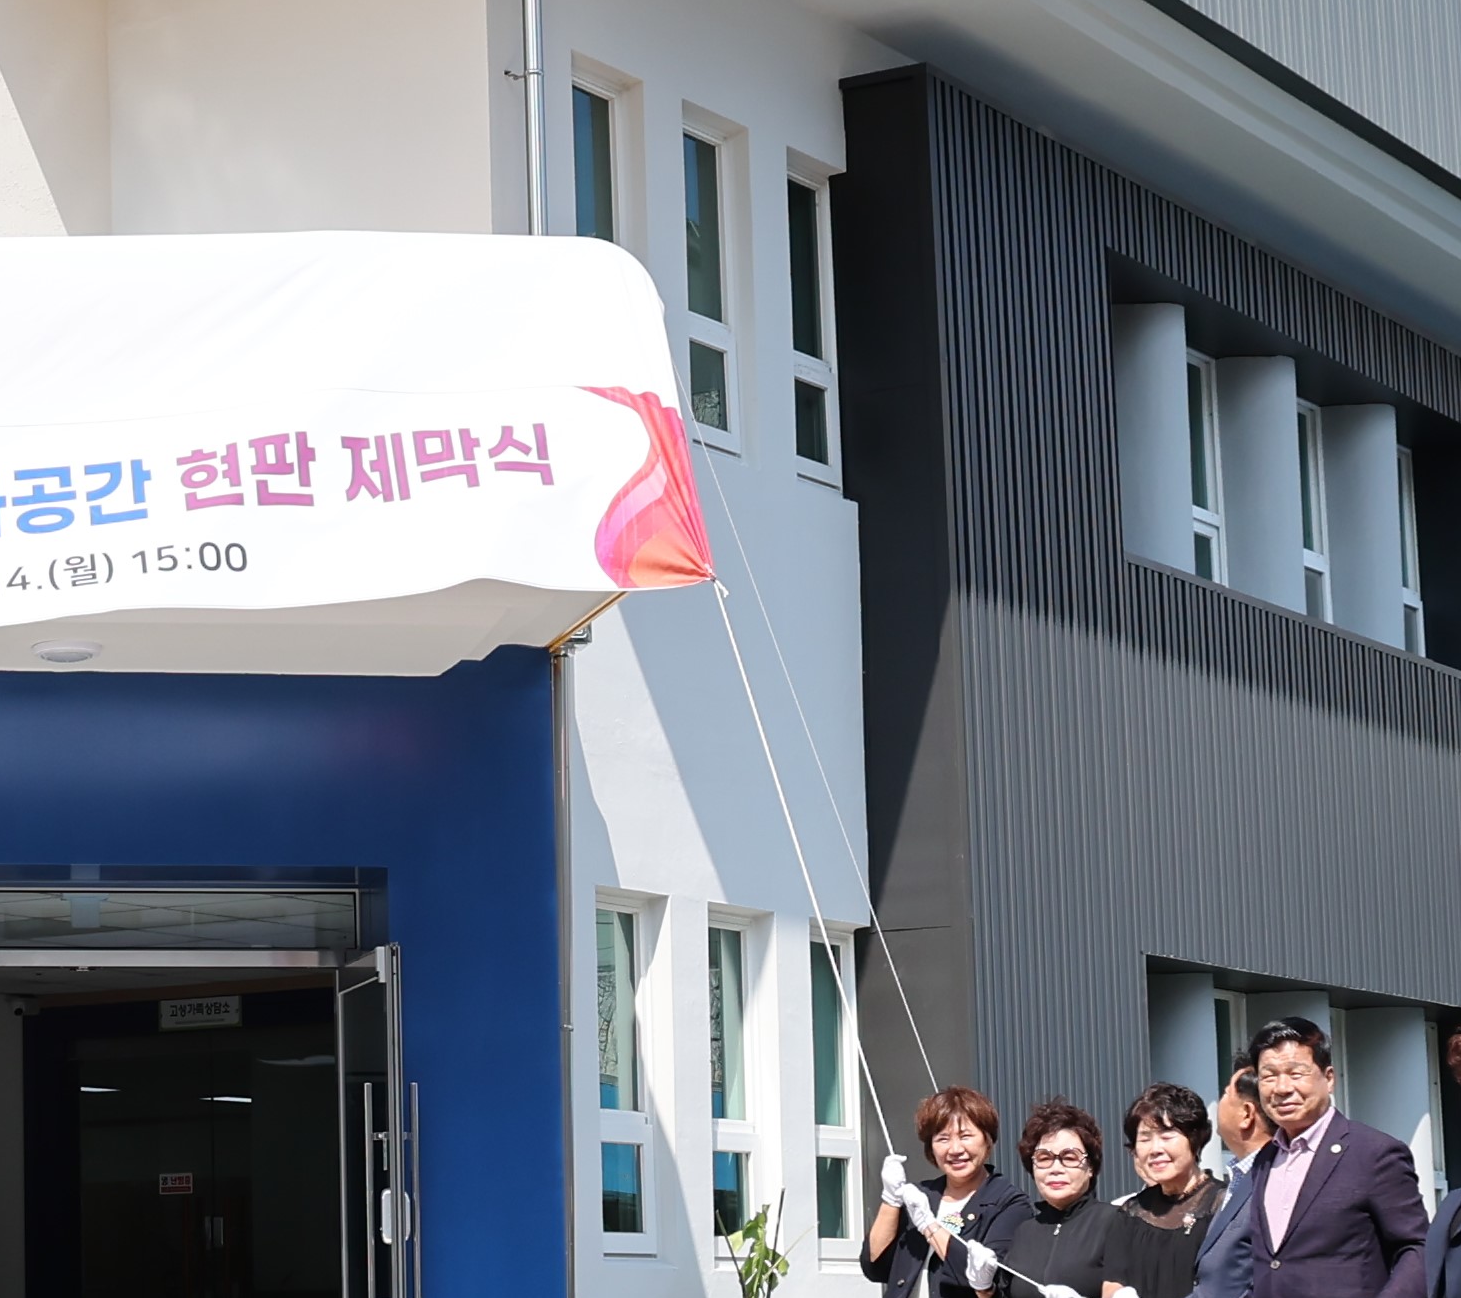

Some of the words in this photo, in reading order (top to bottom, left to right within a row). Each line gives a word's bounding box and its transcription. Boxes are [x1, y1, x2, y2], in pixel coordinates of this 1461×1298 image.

[176, 430, 316, 511] 현판
[340, 422, 555, 504] 제막식
[131, 541, 249, 575] 15:00
